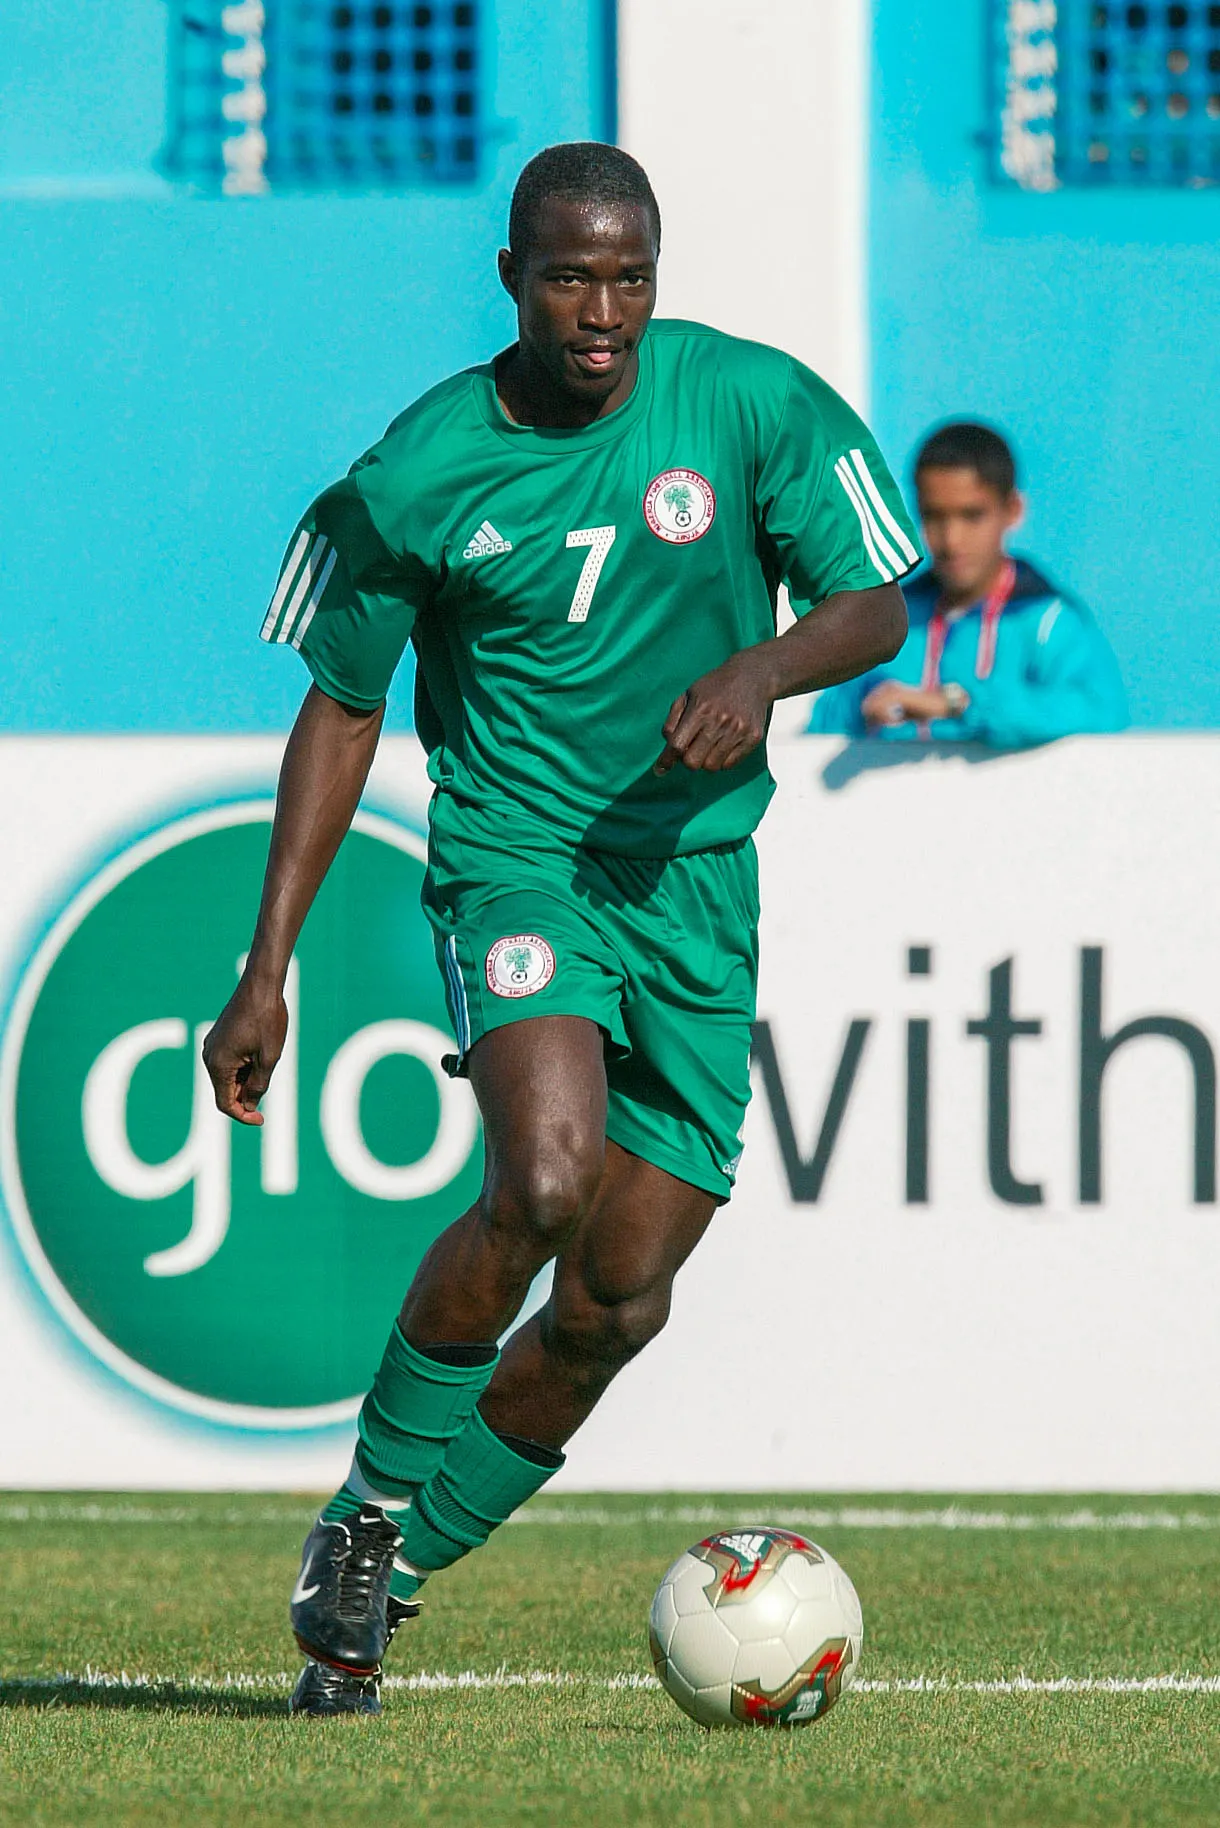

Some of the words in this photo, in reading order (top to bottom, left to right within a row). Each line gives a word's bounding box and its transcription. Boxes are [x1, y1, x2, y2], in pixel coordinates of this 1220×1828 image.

[649, 472, 684, 498] FOOTBALL
[686, 472, 714, 518] ASSOCIATION
[463, 540, 513, 559] adidas
[565, 525, 616, 623] 7
[81, 951, 480, 1277] glo
